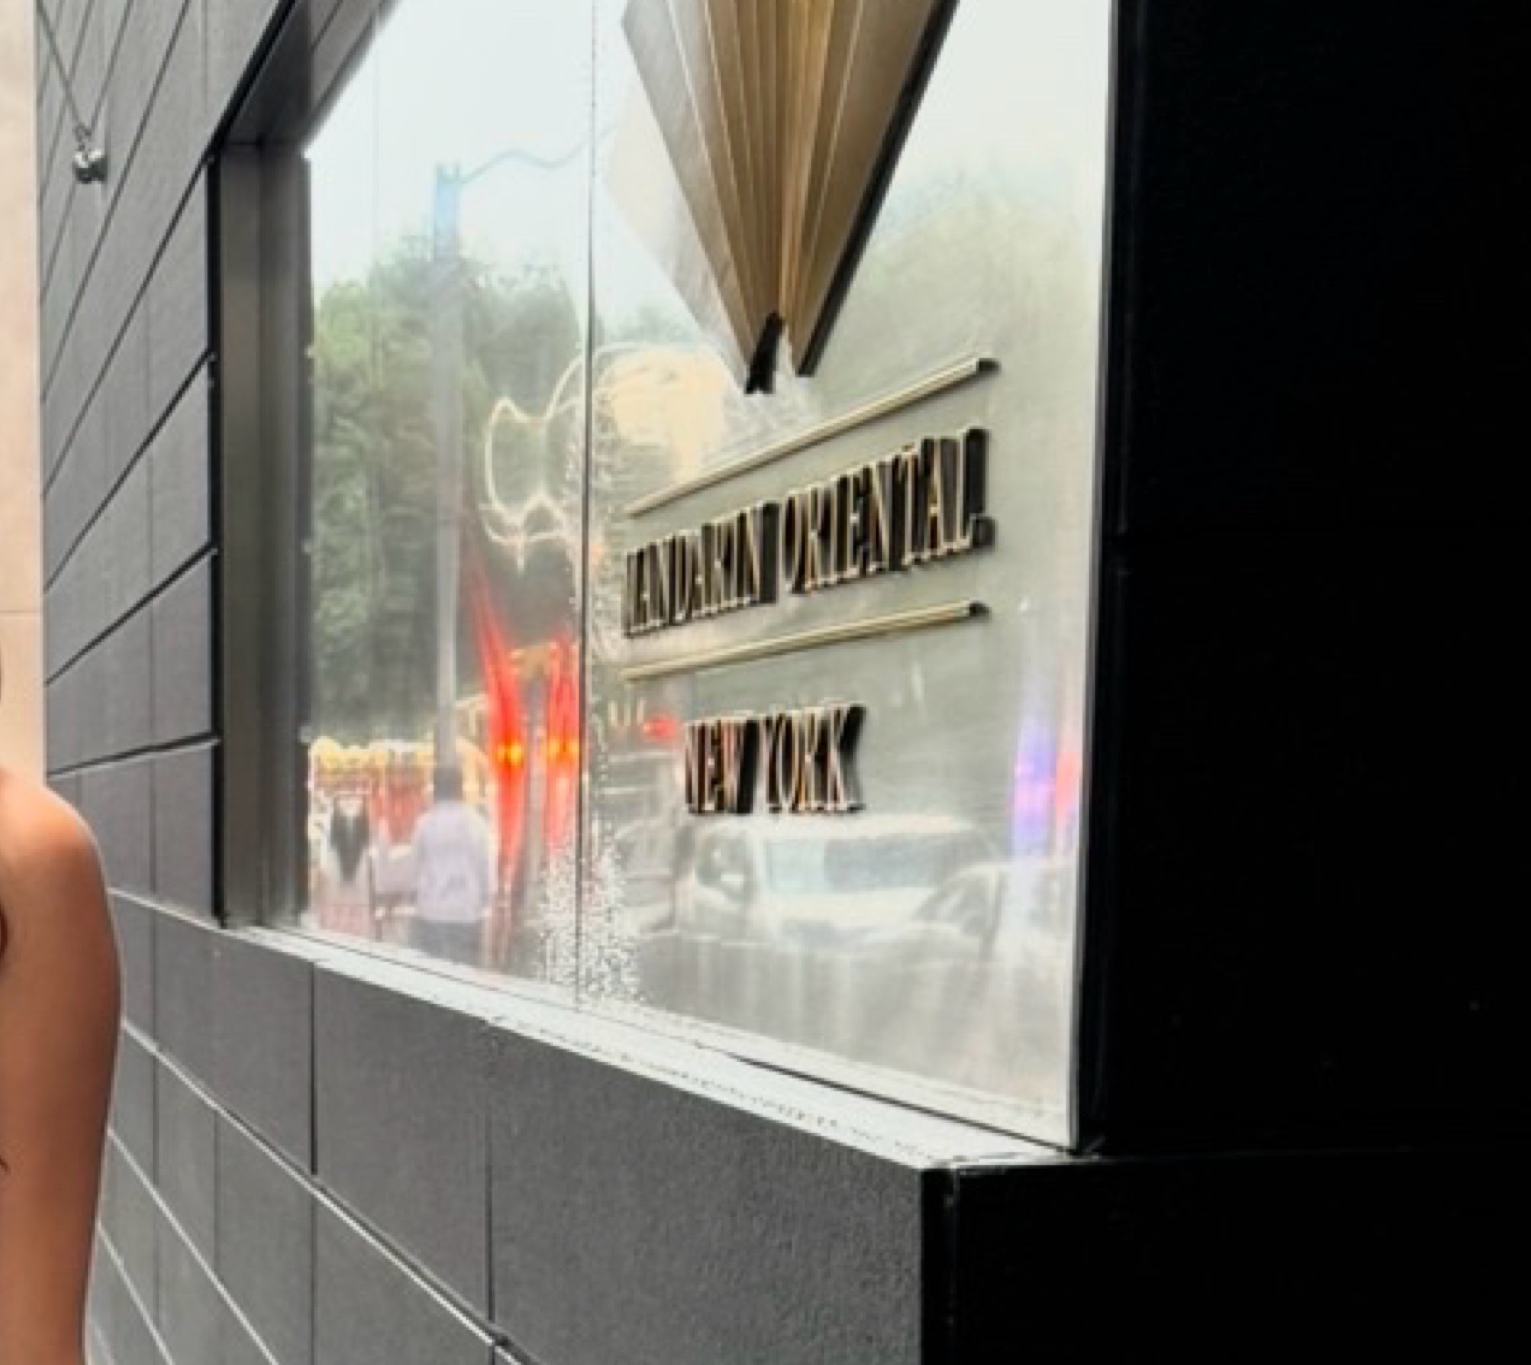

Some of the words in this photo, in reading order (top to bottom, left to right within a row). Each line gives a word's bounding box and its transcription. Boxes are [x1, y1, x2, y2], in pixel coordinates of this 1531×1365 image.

[783, 429, 996, 594] ORIENTAL
[685, 711, 759, 815] NEW
[759, 699, 866, 814] YORK
